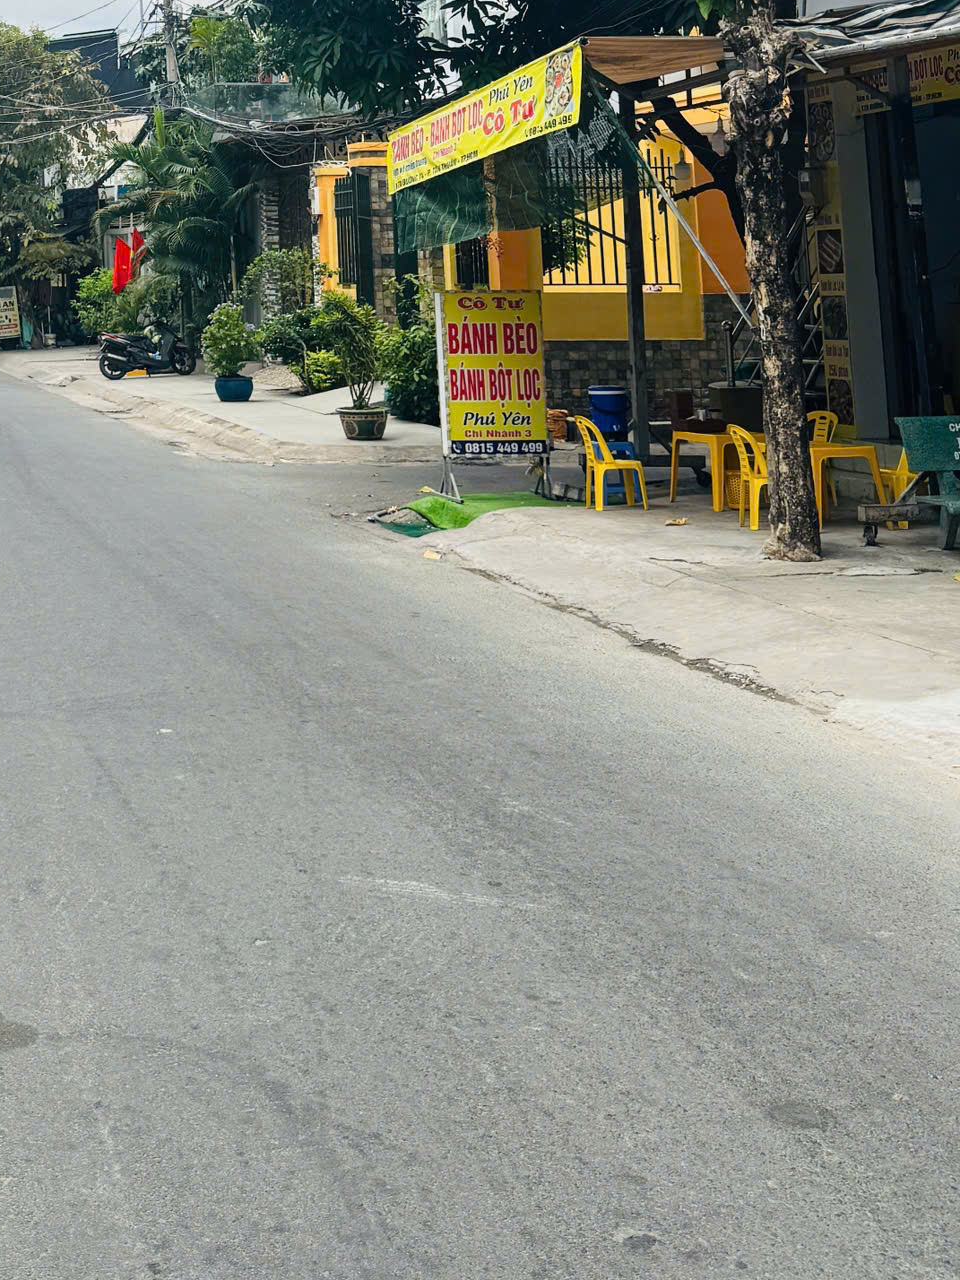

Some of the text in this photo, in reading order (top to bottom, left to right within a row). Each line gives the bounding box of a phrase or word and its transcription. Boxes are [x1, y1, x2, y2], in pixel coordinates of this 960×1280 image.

[929, 55, 944, 81] LỌC
[947, 48, 960, 62] Ph
[488, 75, 533, 106] Phú Yên
[483, 107, 505, 136] Cô
[510, 95, 537, 126] Tư
[2, 300, 15, 308] AN
[457, 296, 525, 310] Cô Tư
[447, 316, 538, 355] BÁNH BÈO
[449, 362, 541, 408] BÁNH BỘT LỌC
[463, 411, 531, 426] Phú Yên
[464, 430, 483, 438] Chi
[524, 430, 532, 438] 3
[465, 442, 543, 453] 0815 449 499
